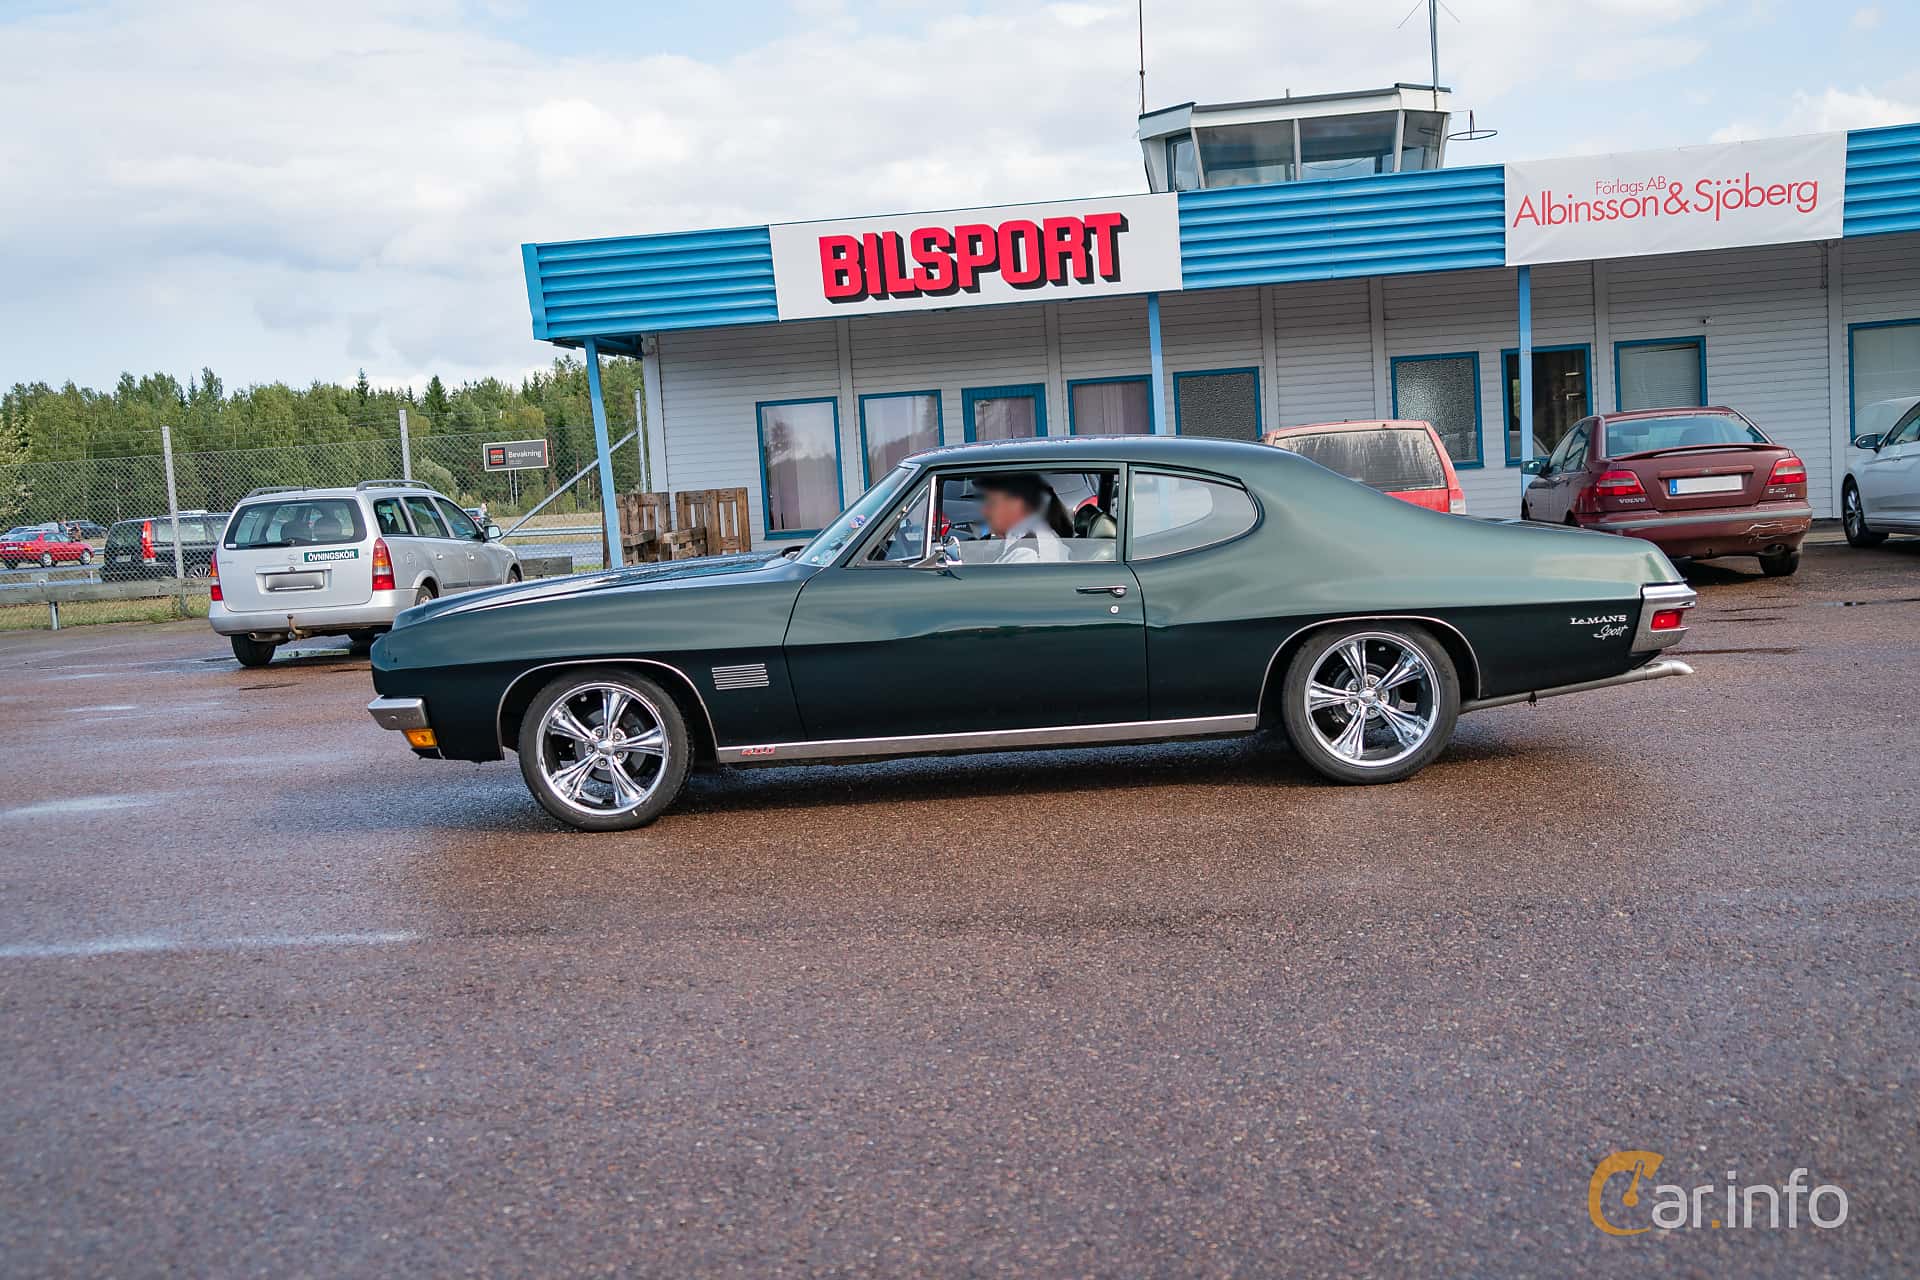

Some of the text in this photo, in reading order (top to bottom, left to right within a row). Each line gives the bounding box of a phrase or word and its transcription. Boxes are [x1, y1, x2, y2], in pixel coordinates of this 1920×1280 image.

[1595, 175, 1667, 197] Förlags AB
[818, 212, 1129, 304] BILSPORT
[508, 448, 542, 459] Bevakning
[308, 549, 355, 561] ÖVNINGSKÖR
[1592, 624, 1629, 640] Sport
